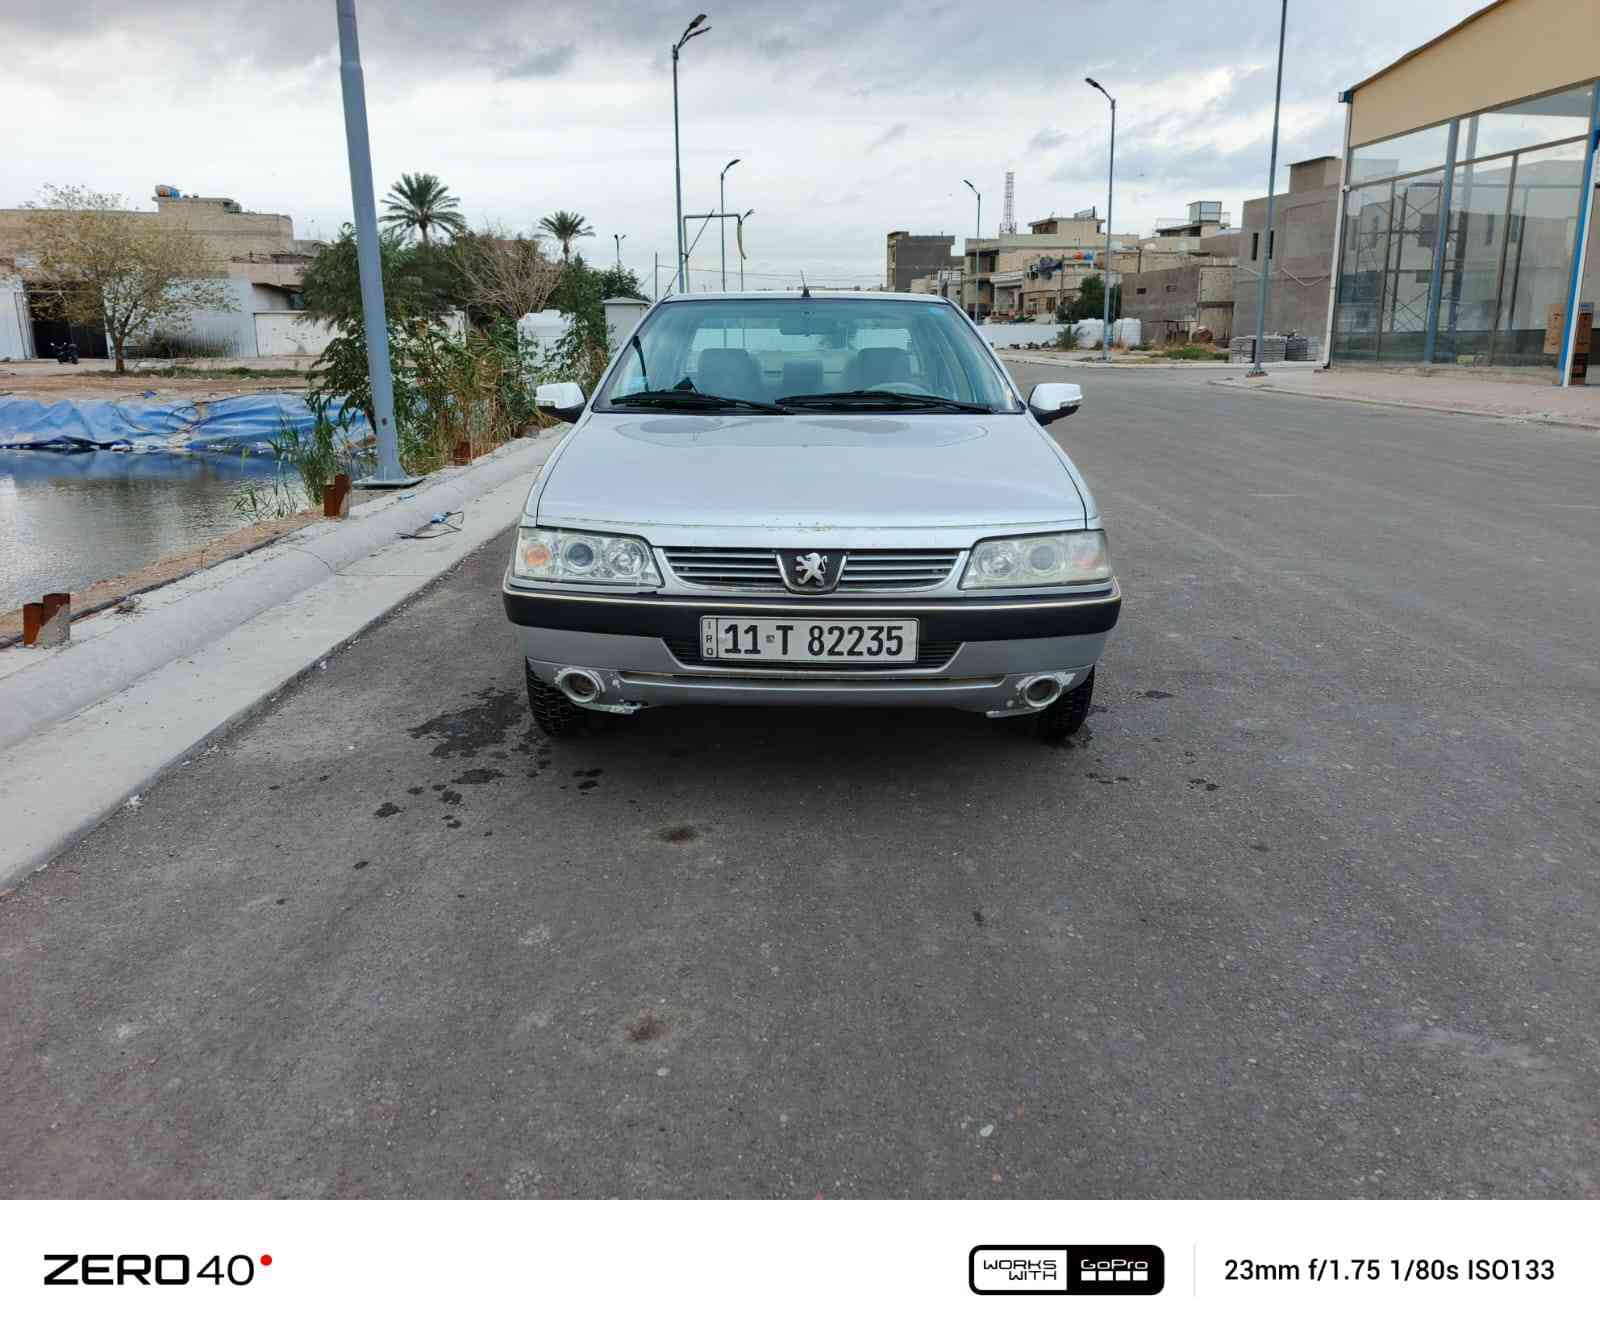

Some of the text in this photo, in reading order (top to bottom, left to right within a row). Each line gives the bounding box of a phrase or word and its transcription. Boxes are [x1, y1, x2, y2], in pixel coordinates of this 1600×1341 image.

[724, 623, 904, 657] 11 T 82235
